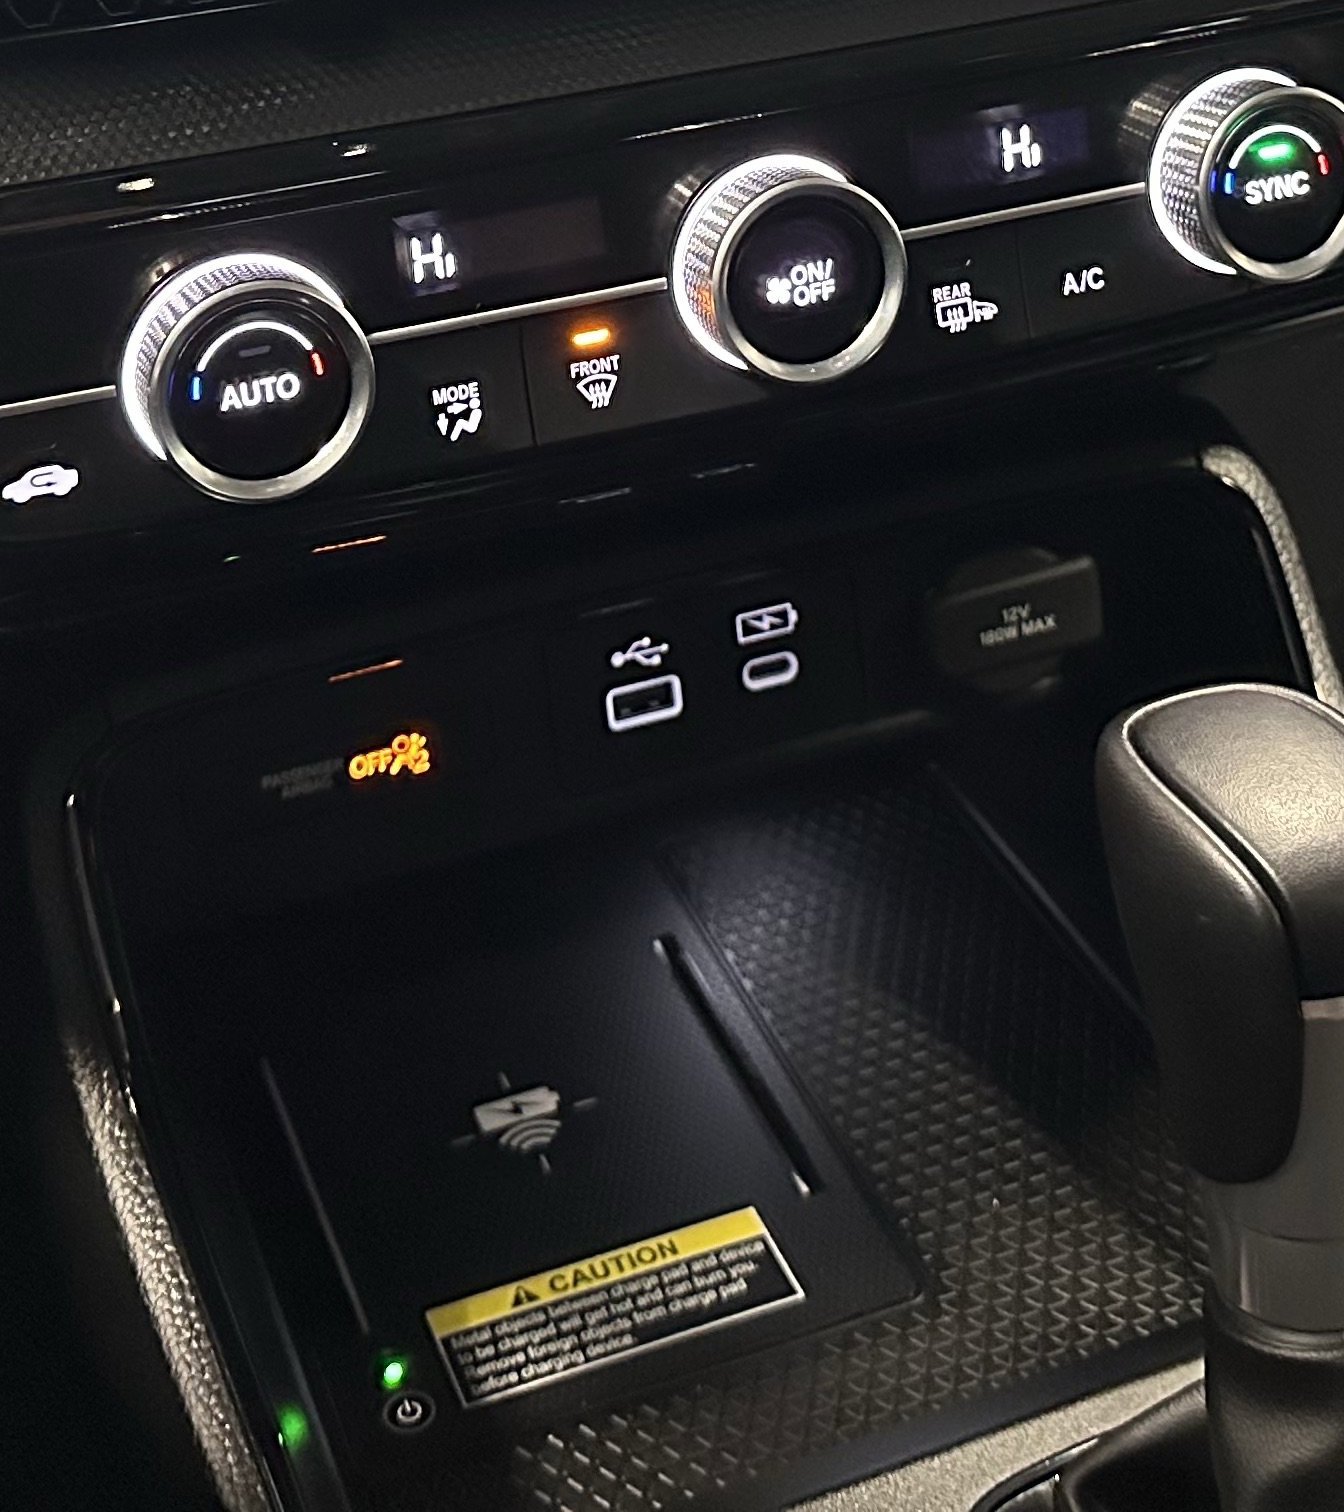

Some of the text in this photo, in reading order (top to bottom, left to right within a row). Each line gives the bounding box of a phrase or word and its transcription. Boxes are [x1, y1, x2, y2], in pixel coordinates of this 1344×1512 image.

[1242, 170, 1311, 207] SYNC
[790, 257, 834, 286] ON/
[1063, 266, 1105, 296] A/C
[792, 277, 836, 307] OFF
[932, 282, 972, 302] REAR
[569, 354, 621, 380] FRONT
[219, 371, 301, 412] AUTO
[430, 380, 480, 406] MODE
[1002, 603, 1031, 624] 12V
[1021, 613, 1056, 636] MAX
[348, 747, 393, 780] OFF
[550, 1239, 678, 1293] CAUTION
[661, 1263, 689, 1285] pad
[690, 1254, 718, 1273] and
[635, 1287, 663, 1307] and
[718, 1277, 747, 1303] pad
